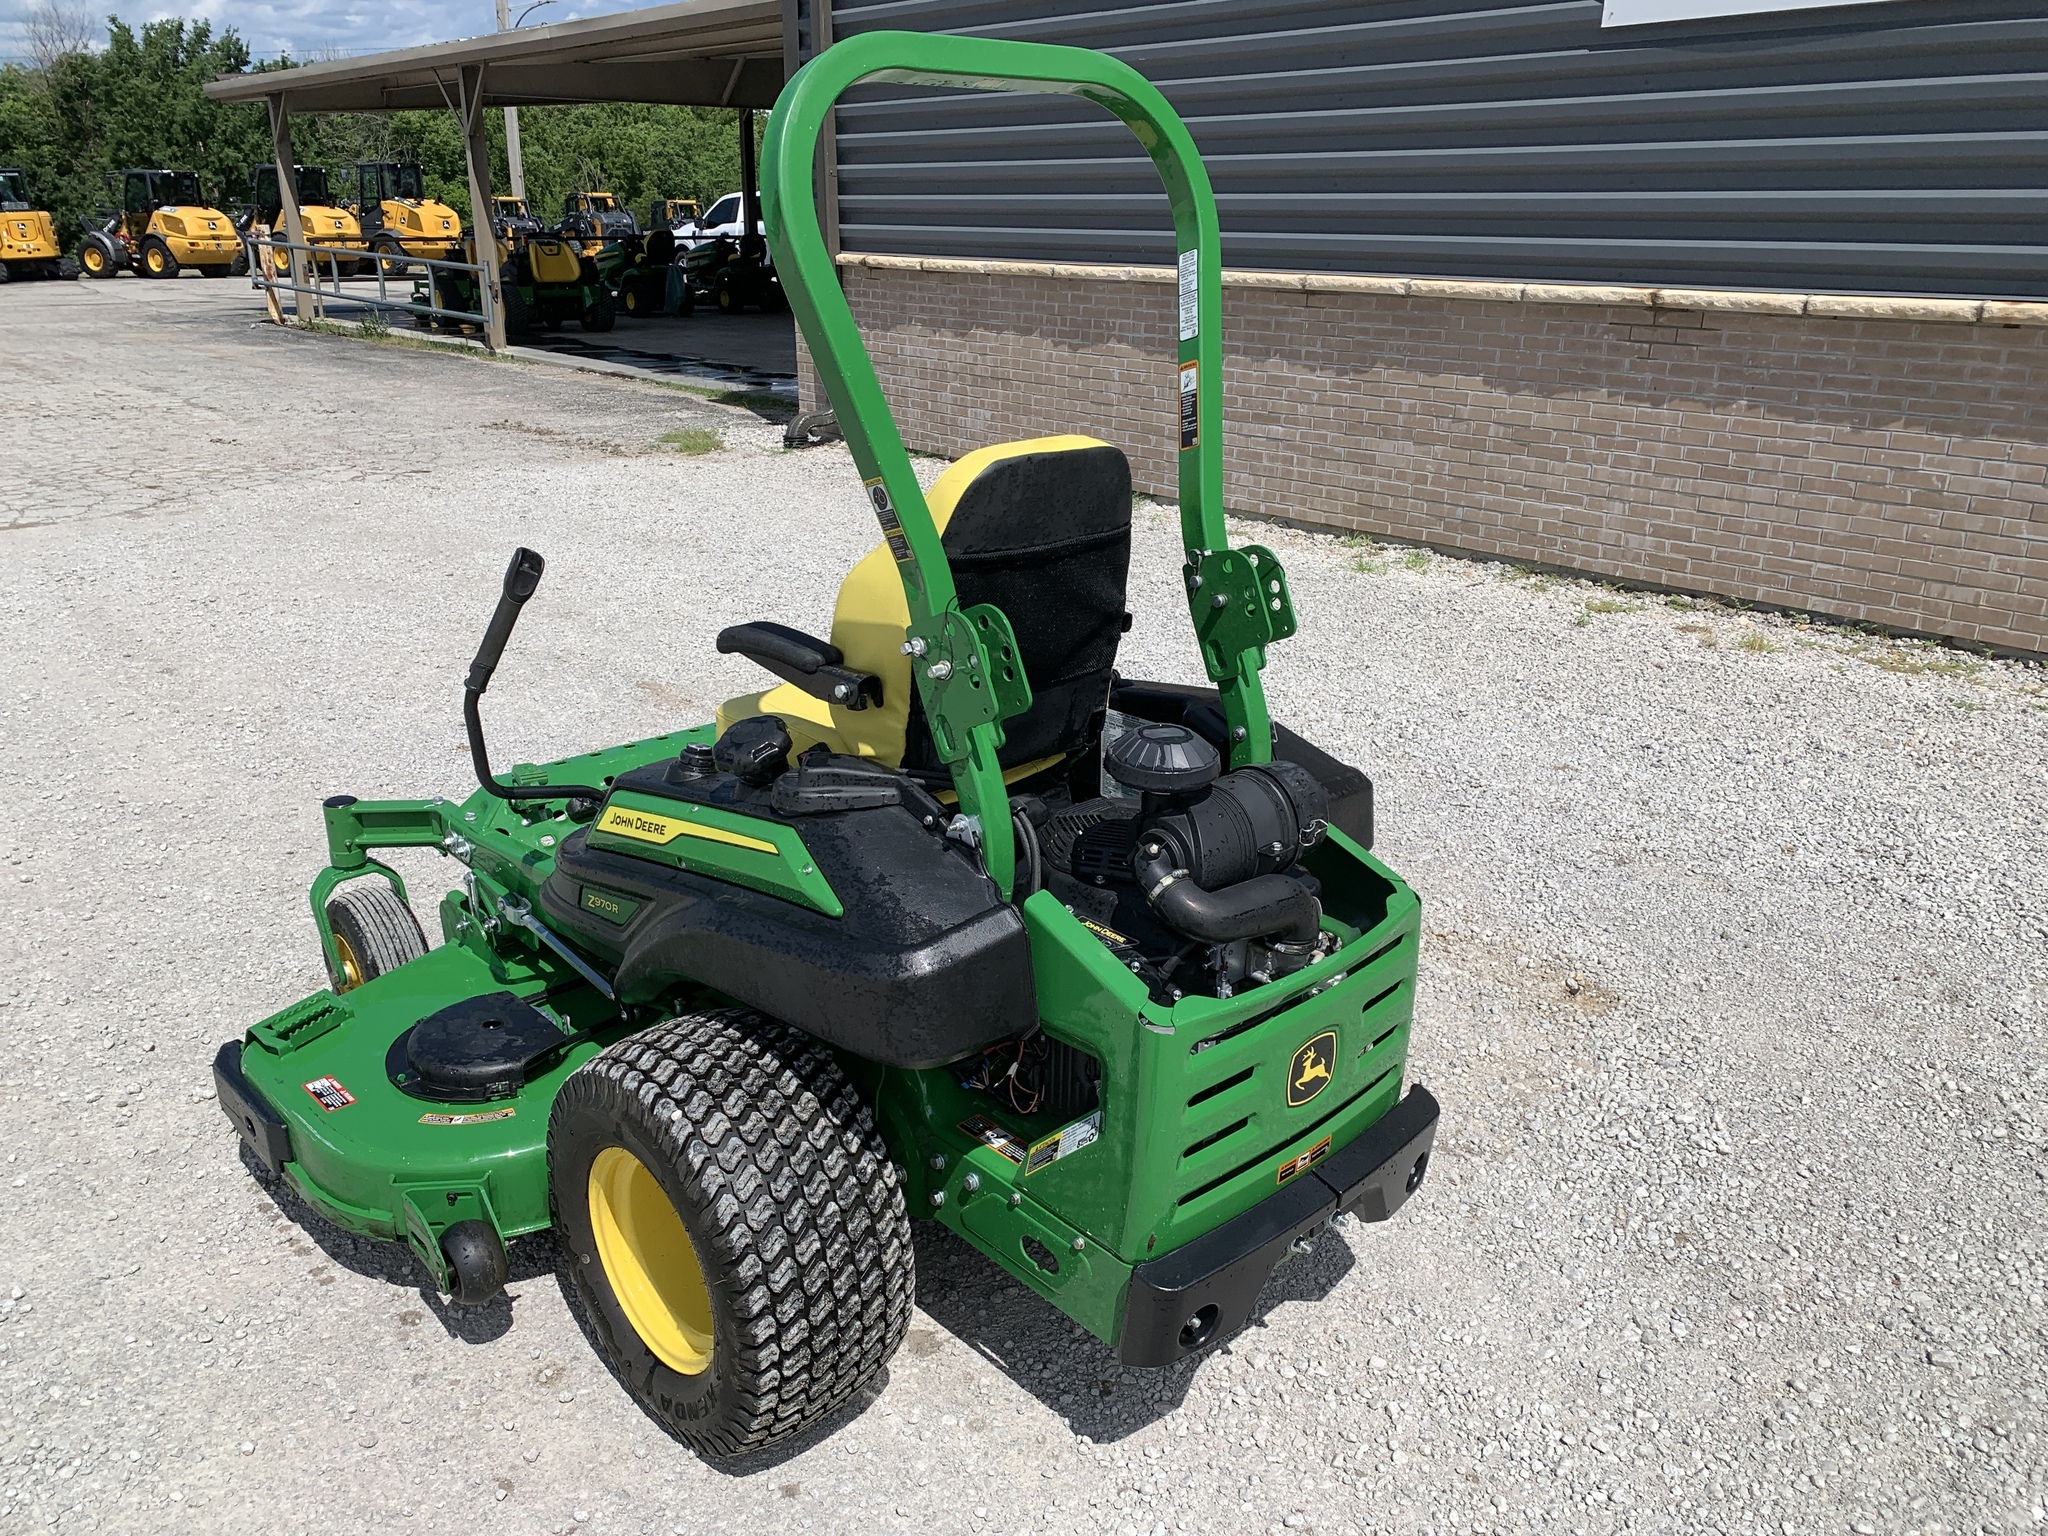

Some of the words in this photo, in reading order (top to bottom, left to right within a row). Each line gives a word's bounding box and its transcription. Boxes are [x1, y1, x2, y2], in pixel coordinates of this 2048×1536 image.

[610, 812, 634, 828] JOHN
[634, 817, 667, 835] DEERE
[587, 894, 619, 914] Z970R
[1081, 921, 1102, 932] JOHN
[1101, 928, 1127, 943] DEERE
